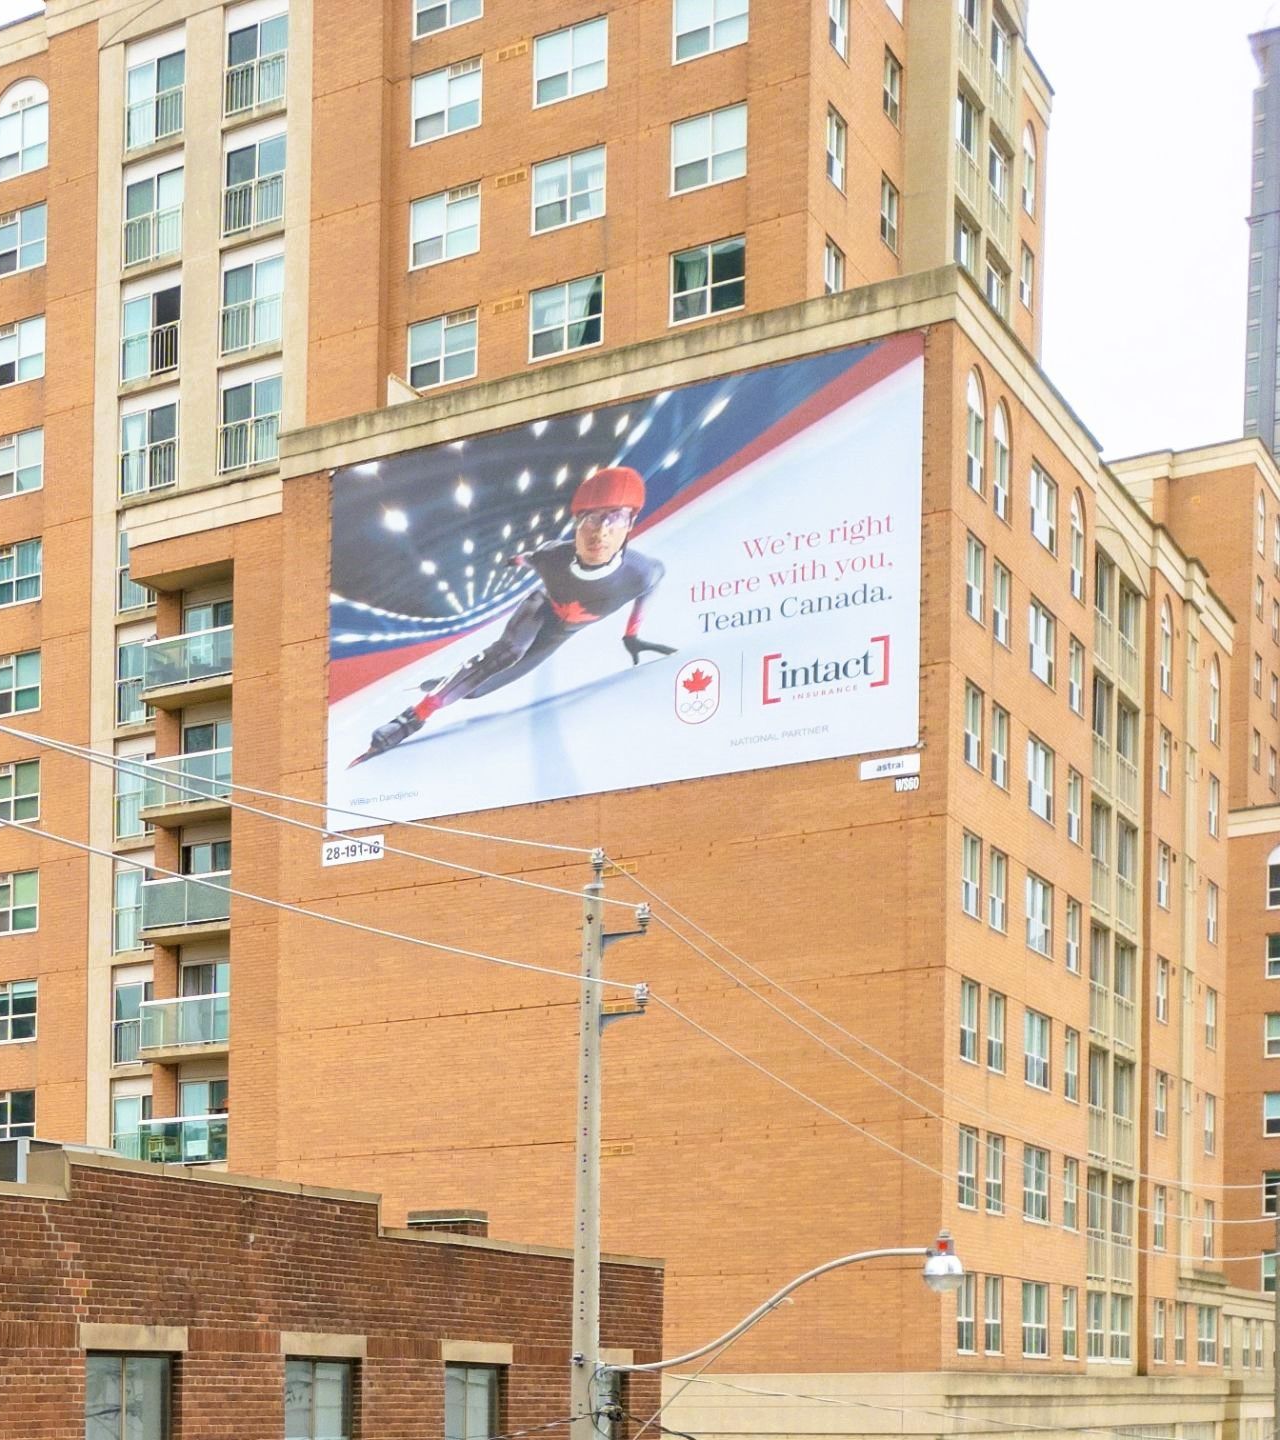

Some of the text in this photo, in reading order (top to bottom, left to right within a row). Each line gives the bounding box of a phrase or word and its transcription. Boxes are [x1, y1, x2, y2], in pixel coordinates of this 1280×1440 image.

[743, 515, 894, 559] We're right
[690, 575, 760, 603] there
[768, 560, 827, 588] with
[699, 583, 893, 633] Team Canada.
[792, 683, 859, 701] INSURANCE
[730, 724, 829, 747] NATIONAL PARTNER
